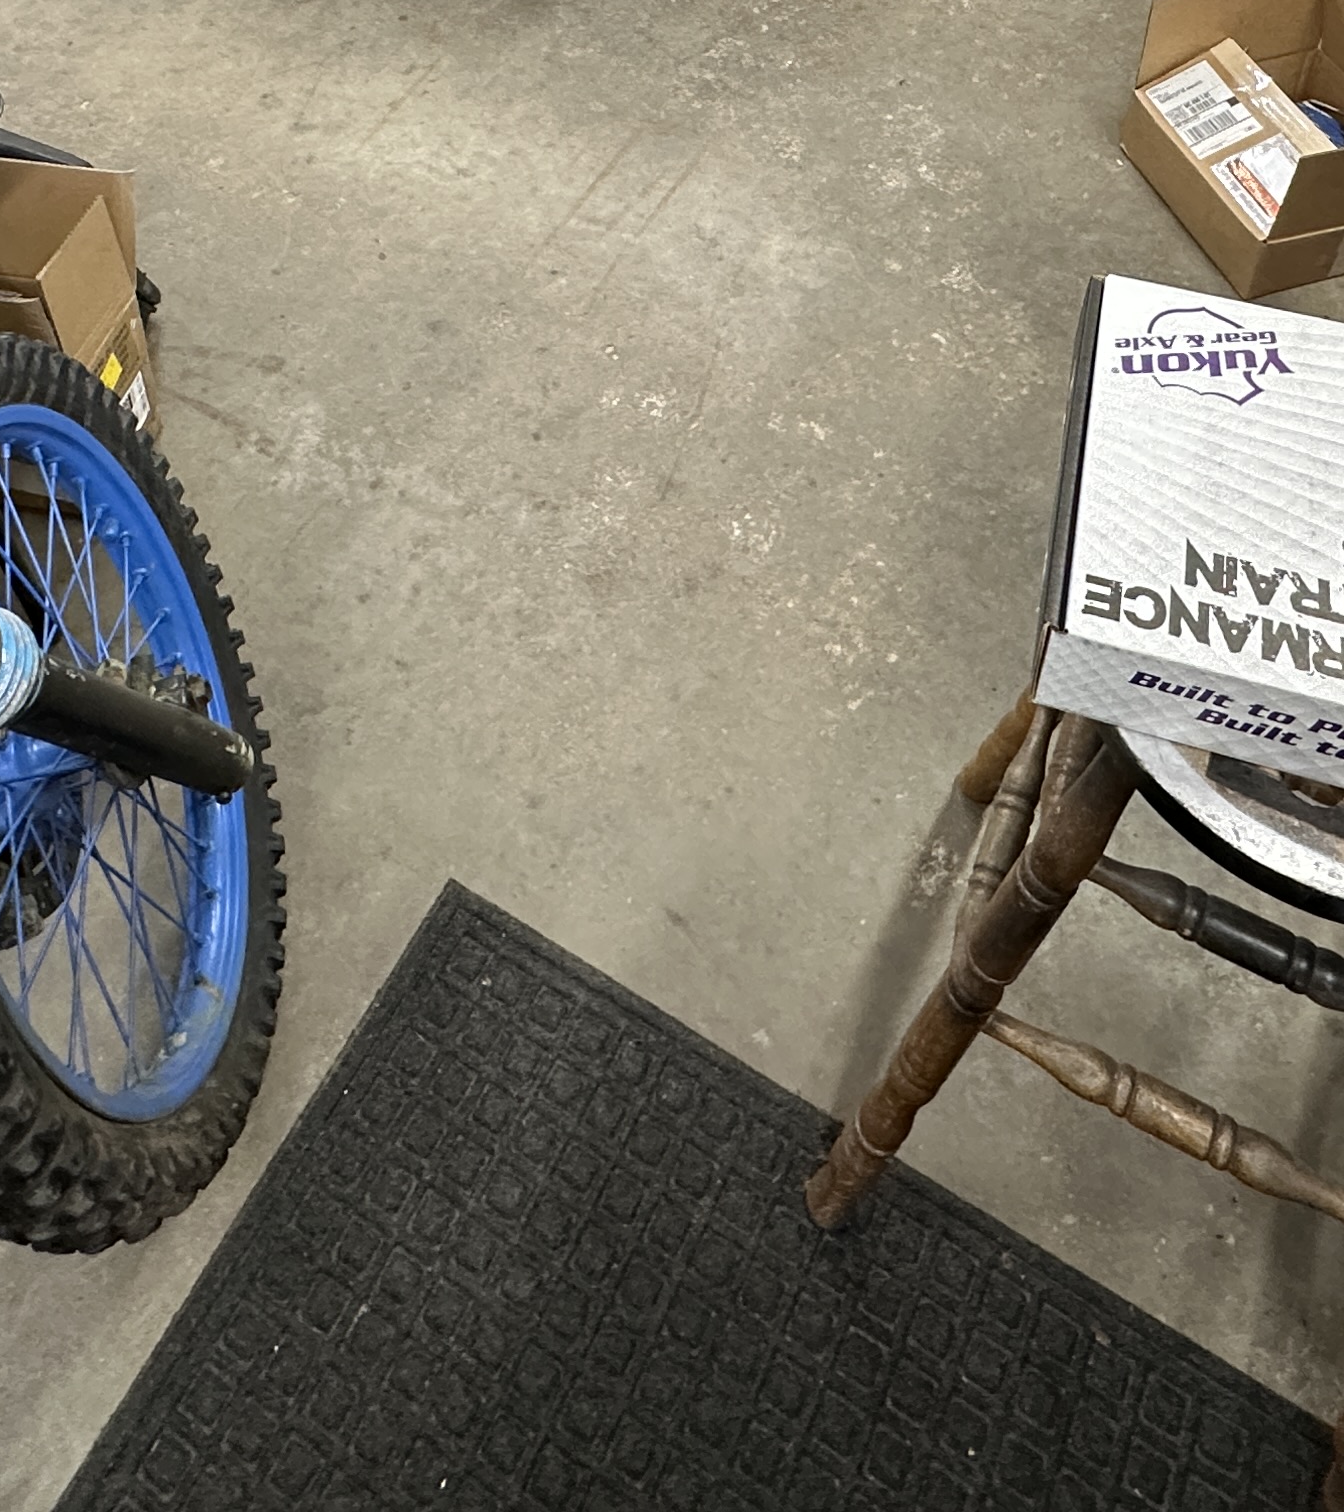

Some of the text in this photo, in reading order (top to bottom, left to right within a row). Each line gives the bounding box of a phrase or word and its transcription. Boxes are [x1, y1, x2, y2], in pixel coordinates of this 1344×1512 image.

[1114, 330, 1278, 351] Gear & Axle
[1121, 347, 1295, 376] Yukon
[1127, 670, 1241, 709] Built
[1248, 702, 1295, 727] to
[1194, 709, 1303, 748] Built
